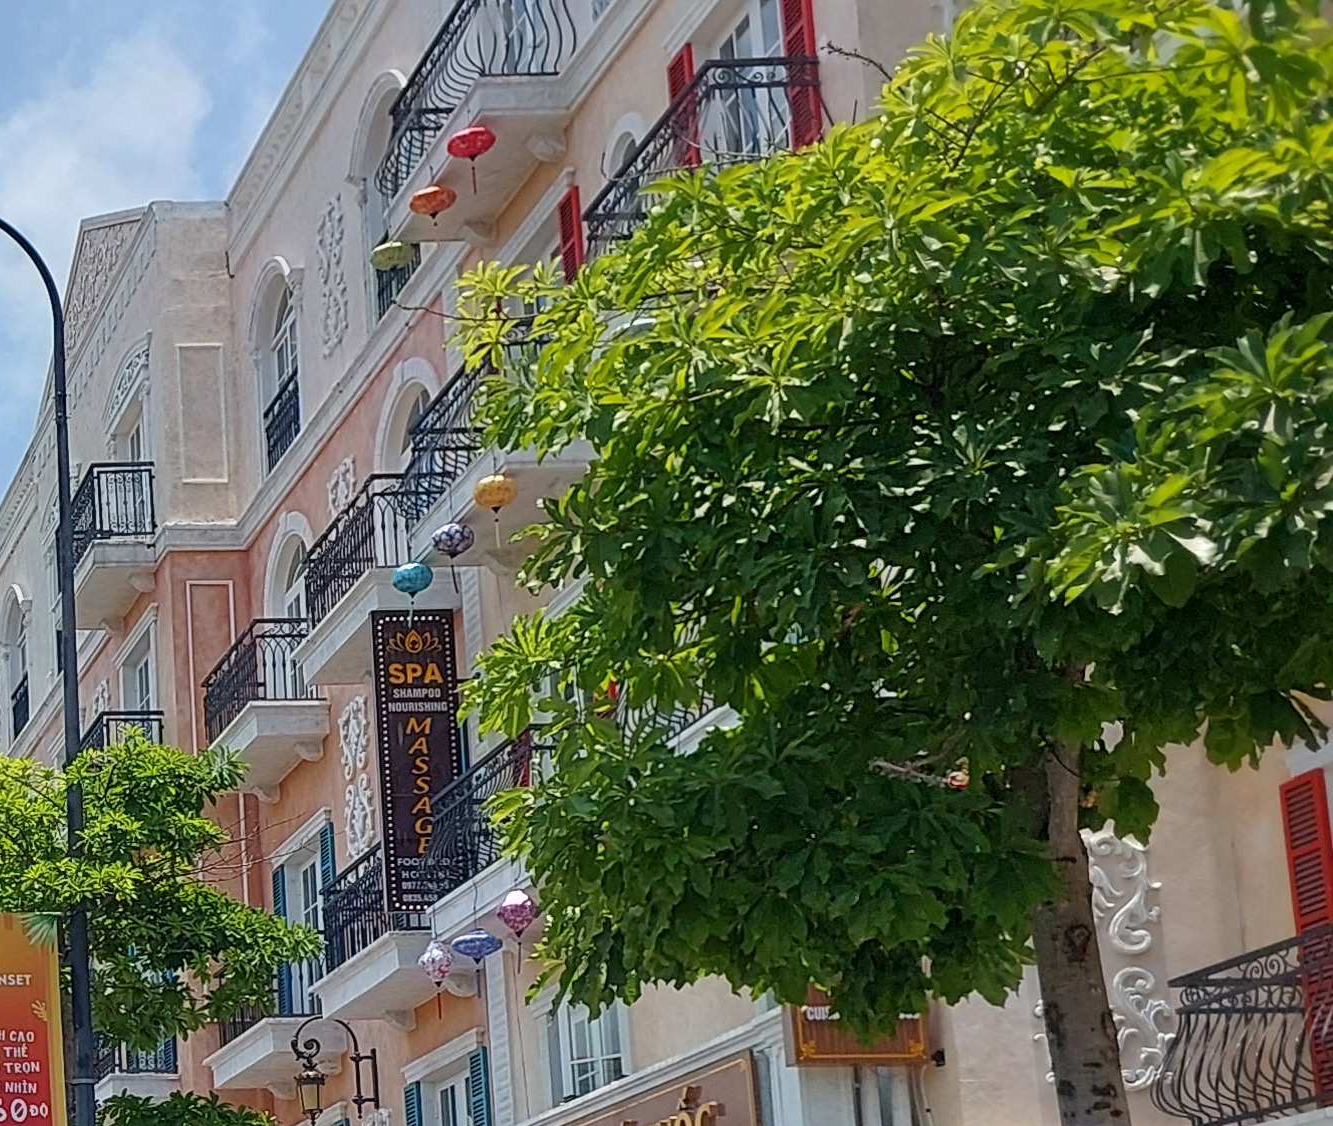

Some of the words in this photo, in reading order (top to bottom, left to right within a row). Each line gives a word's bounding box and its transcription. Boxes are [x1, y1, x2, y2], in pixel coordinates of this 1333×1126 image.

[388, 663, 443, 684] SPA
[393, 688, 441, 698] SHAMPOO
[388, 701, 448, 712] NOURISHING
[406, 717, 434, 853] MASSAGE
[9, 1031, 35, 1042] CAO
[3, 1043, 28, 1058] THẾ
[3, 1061, 41, 1074] TRỌN
[5, 1080, 37, 1094] NHÌN
[29, 1102, 49, 1118] ĐỘ
